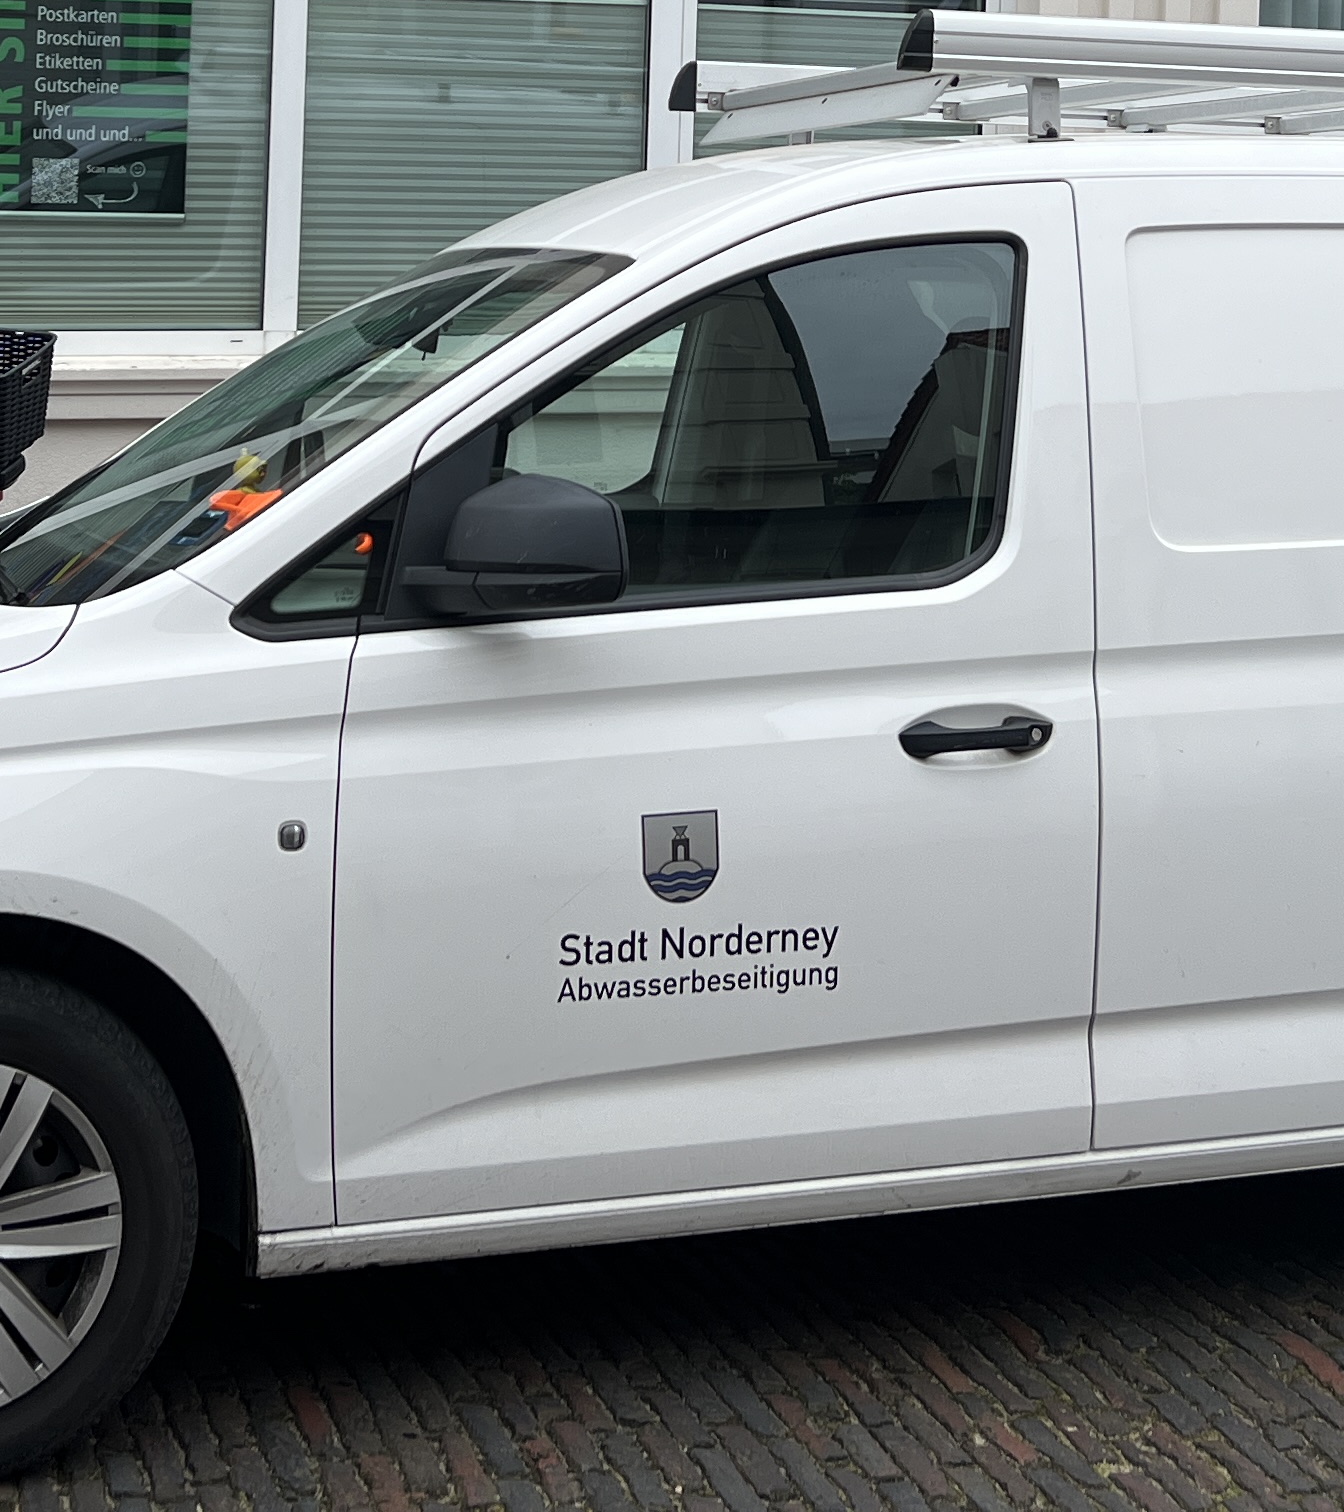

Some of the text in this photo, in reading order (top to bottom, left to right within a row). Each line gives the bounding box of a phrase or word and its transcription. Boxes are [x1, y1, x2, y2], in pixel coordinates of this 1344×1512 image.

[37, 6, 117, 24] Postkarten
[36, 29, 121, 47] Broschüren
[35, 53, 102, 70] Etiketten
[34, 77, 119, 94] Gutscheine
[33, 100, 70, 121] Flyer
[32, 124, 63, 140] und
[66, 125, 96, 141] und
[558, 923, 839, 967] Stadt Norderney
[557, 964, 839, 1003] Abwasserbeseitigung
